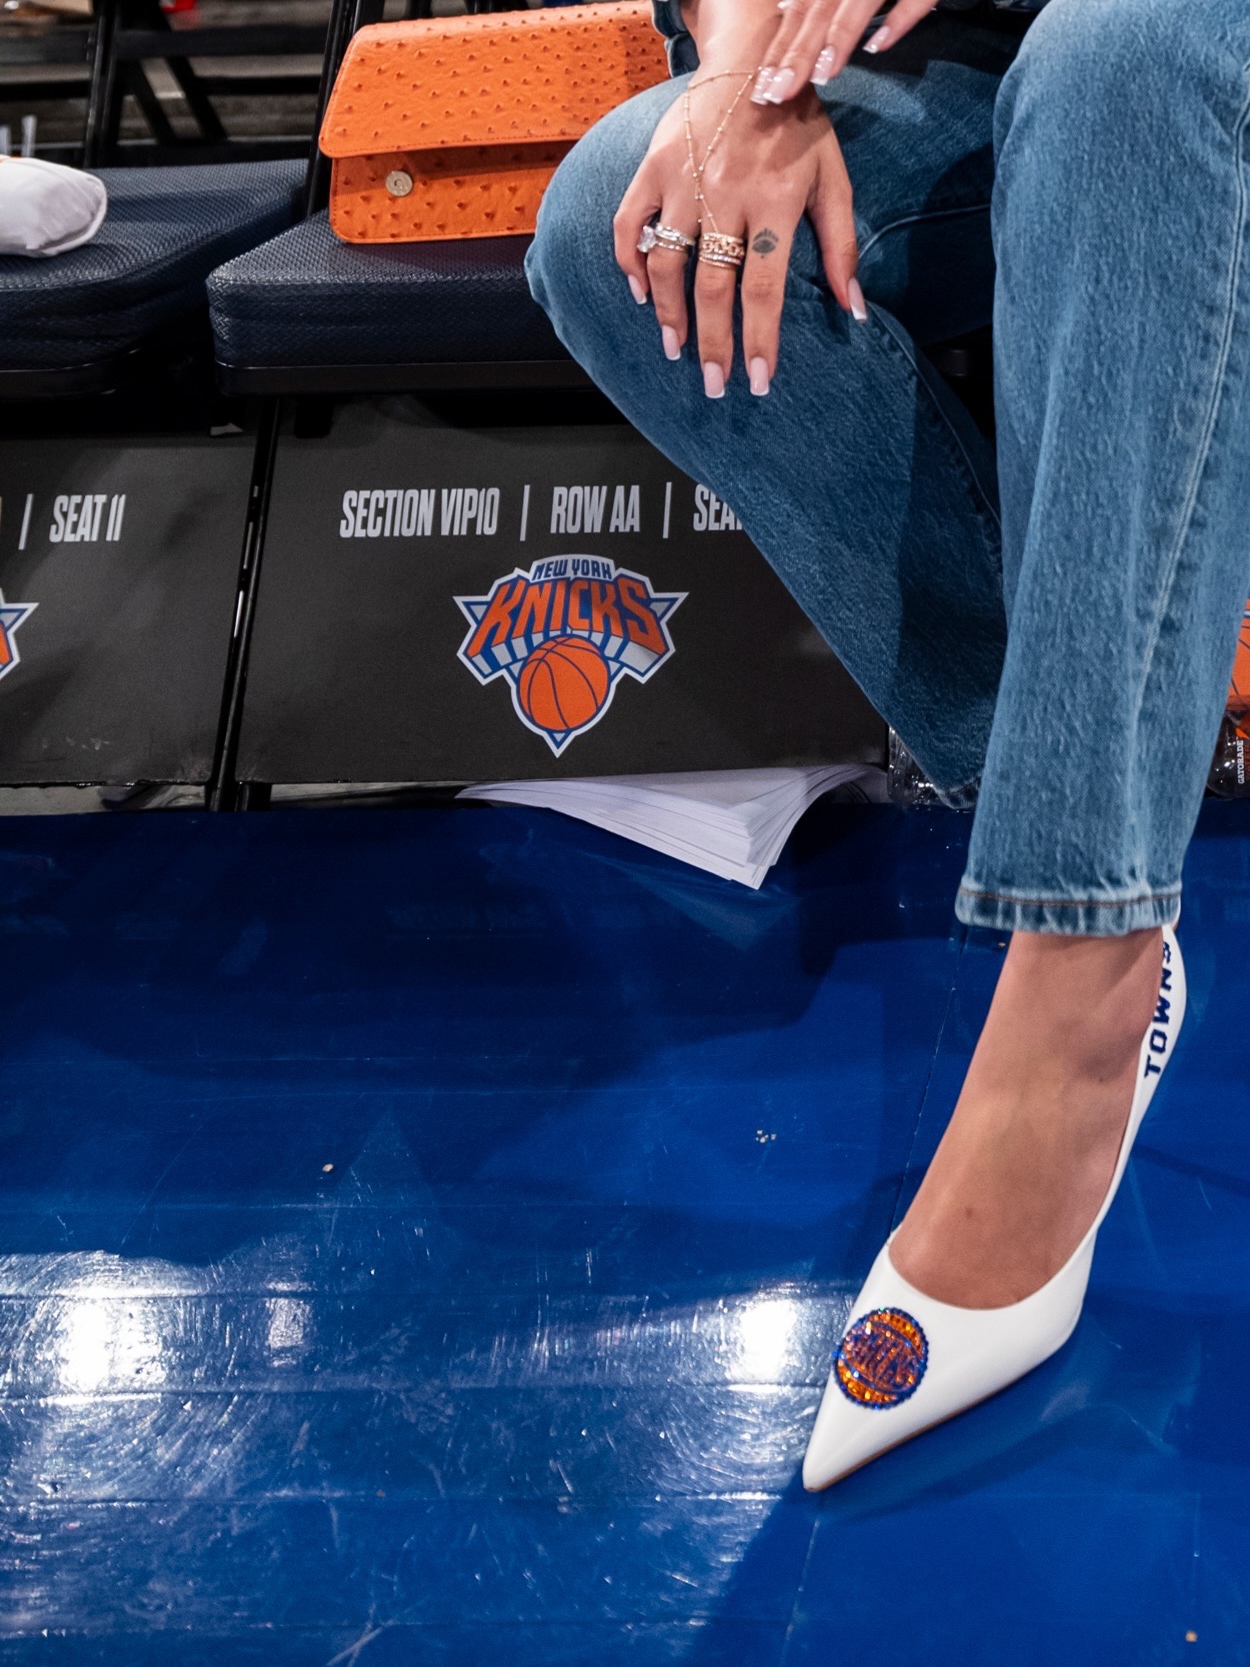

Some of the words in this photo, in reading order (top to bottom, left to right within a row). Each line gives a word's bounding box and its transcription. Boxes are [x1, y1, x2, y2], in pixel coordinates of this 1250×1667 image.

[49, 494, 107, 543] SEAT
[105, 494, 126, 541] 11
[339, 489, 436, 538] SECTION
[440, 487, 500, 536] VIP10
[550, 486, 607, 534] ROW
[609, 485, 640, 532] AA
[693, 484, 743, 531] SEA
[531, 559, 568, 581] NEW
[571, 558, 613, 579] YORK
[465, 576, 668, 658] KNICKS
[1236, 740, 1245, 784] GATORADE
